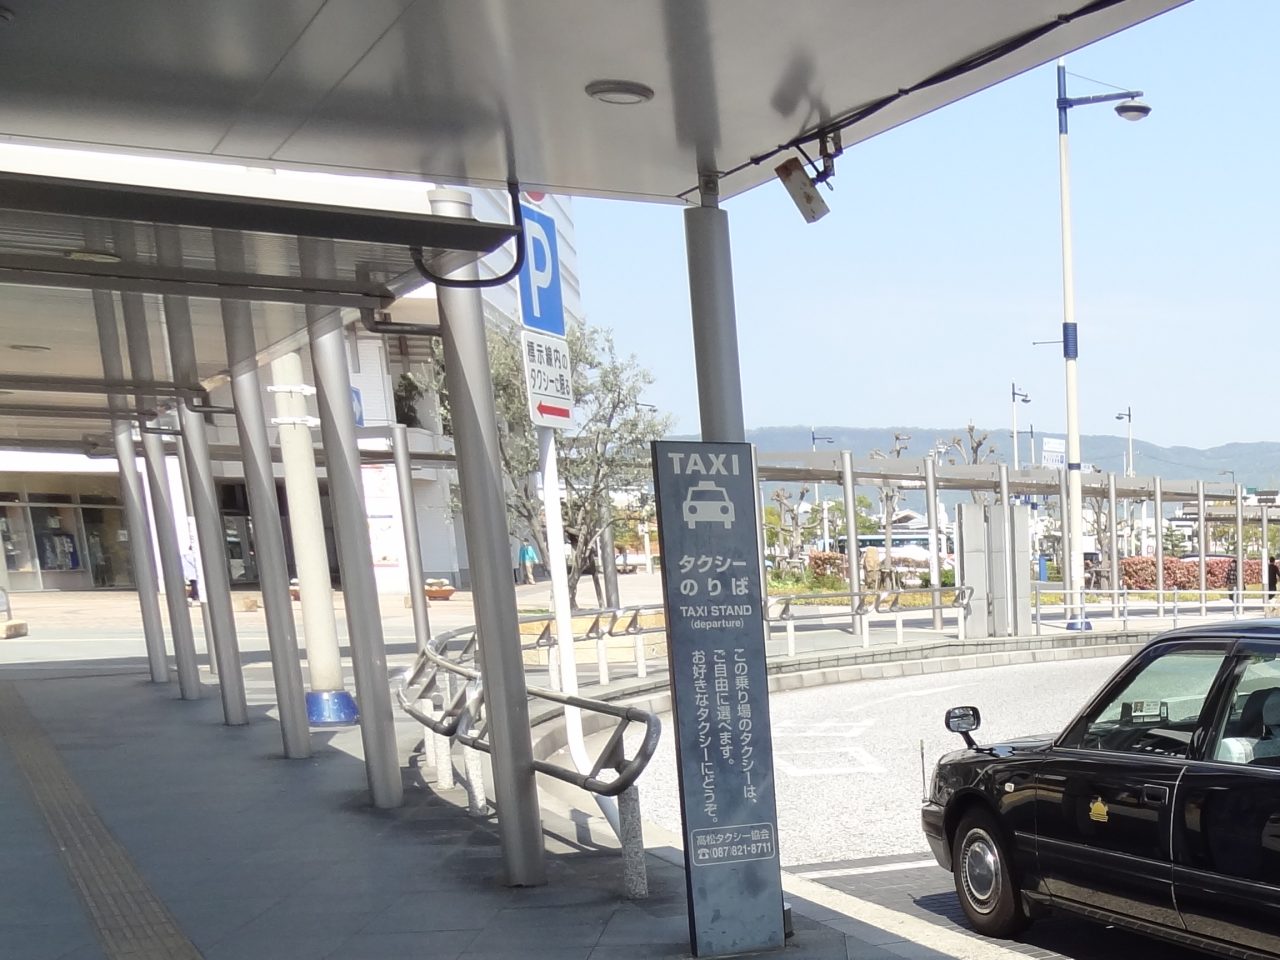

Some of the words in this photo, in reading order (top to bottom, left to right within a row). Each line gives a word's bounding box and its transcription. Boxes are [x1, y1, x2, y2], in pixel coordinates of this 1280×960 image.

[524, 217, 552, 318] P
[530, 368, 571, 396] タクシーに限る
[668, 453, 740, 476] TAXI
[678, 554, 747, 573] タクシー
[680, 577, 749, 597] のりば
[680, 605, 708, 617] TAXI
[711, 604, 752, 616] STAND
[690, 618, 744, 630] (departure)
[714, 649, 735, 766] ご自由に選べます。
[692, 650, 719, 823] お好きなタクシーにどうぞ。
[734, 648, 758, 805] この乗り場のタクシーは、
[696, 828, 770, 846] 高松タクシー協会
